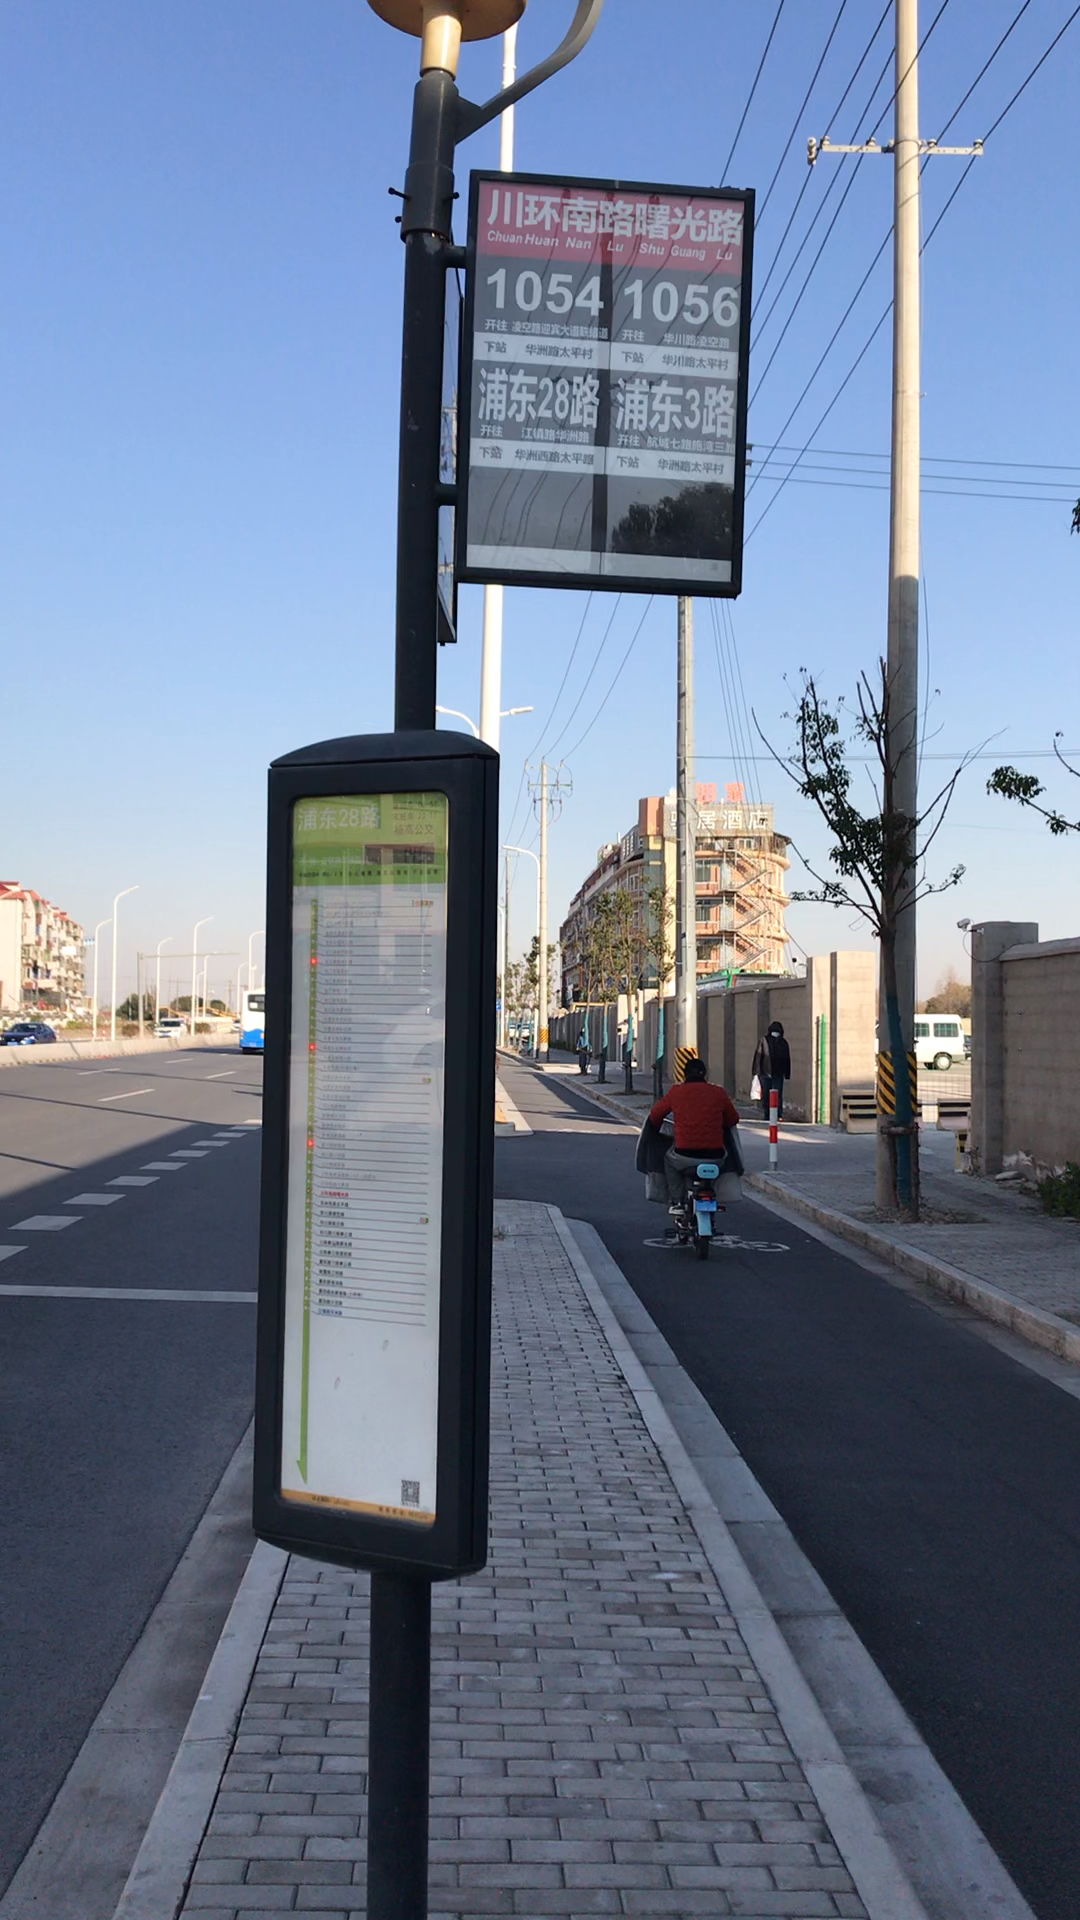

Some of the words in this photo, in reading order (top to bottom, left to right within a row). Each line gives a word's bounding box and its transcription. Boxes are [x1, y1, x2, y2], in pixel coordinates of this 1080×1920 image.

[487, 189, 743, 246] 川环南路曙光路
[487, 230, 523, 244] Chuan
[525, 235, 559, 247] Huan
[566, 237, 592, 249] Nan
[607, 242, 624, 252] Lu
[639, 243, 665, 256] Shu
[671, 245, 706, 261] Guang
[716, 249, 733, 261] Lu
[487, 268, 604, 316] 1054
[624, 279, 739, 327] 1056
[484, 319, 508, 332] 开往
[622, 329, 645, 342] 开往
[484, 341, 507, 354] 下站
[525, 344, 593, 360] 华洲路太平村
[621, 351, 644, 365] 下站
[478, 367, 600, 428] 浦东28路
[615, 378, 735, 439] 浦东3路
[480, 424, 503, 437] 开往
[617, 433, 640, 447] 开往
[479, 446, 502, 459] 下站
[616, 456, 639, 468] 下站
[657, 458, 724, 475] 华洲路太平村
[298, 805, 380, 831] 浦东28路
